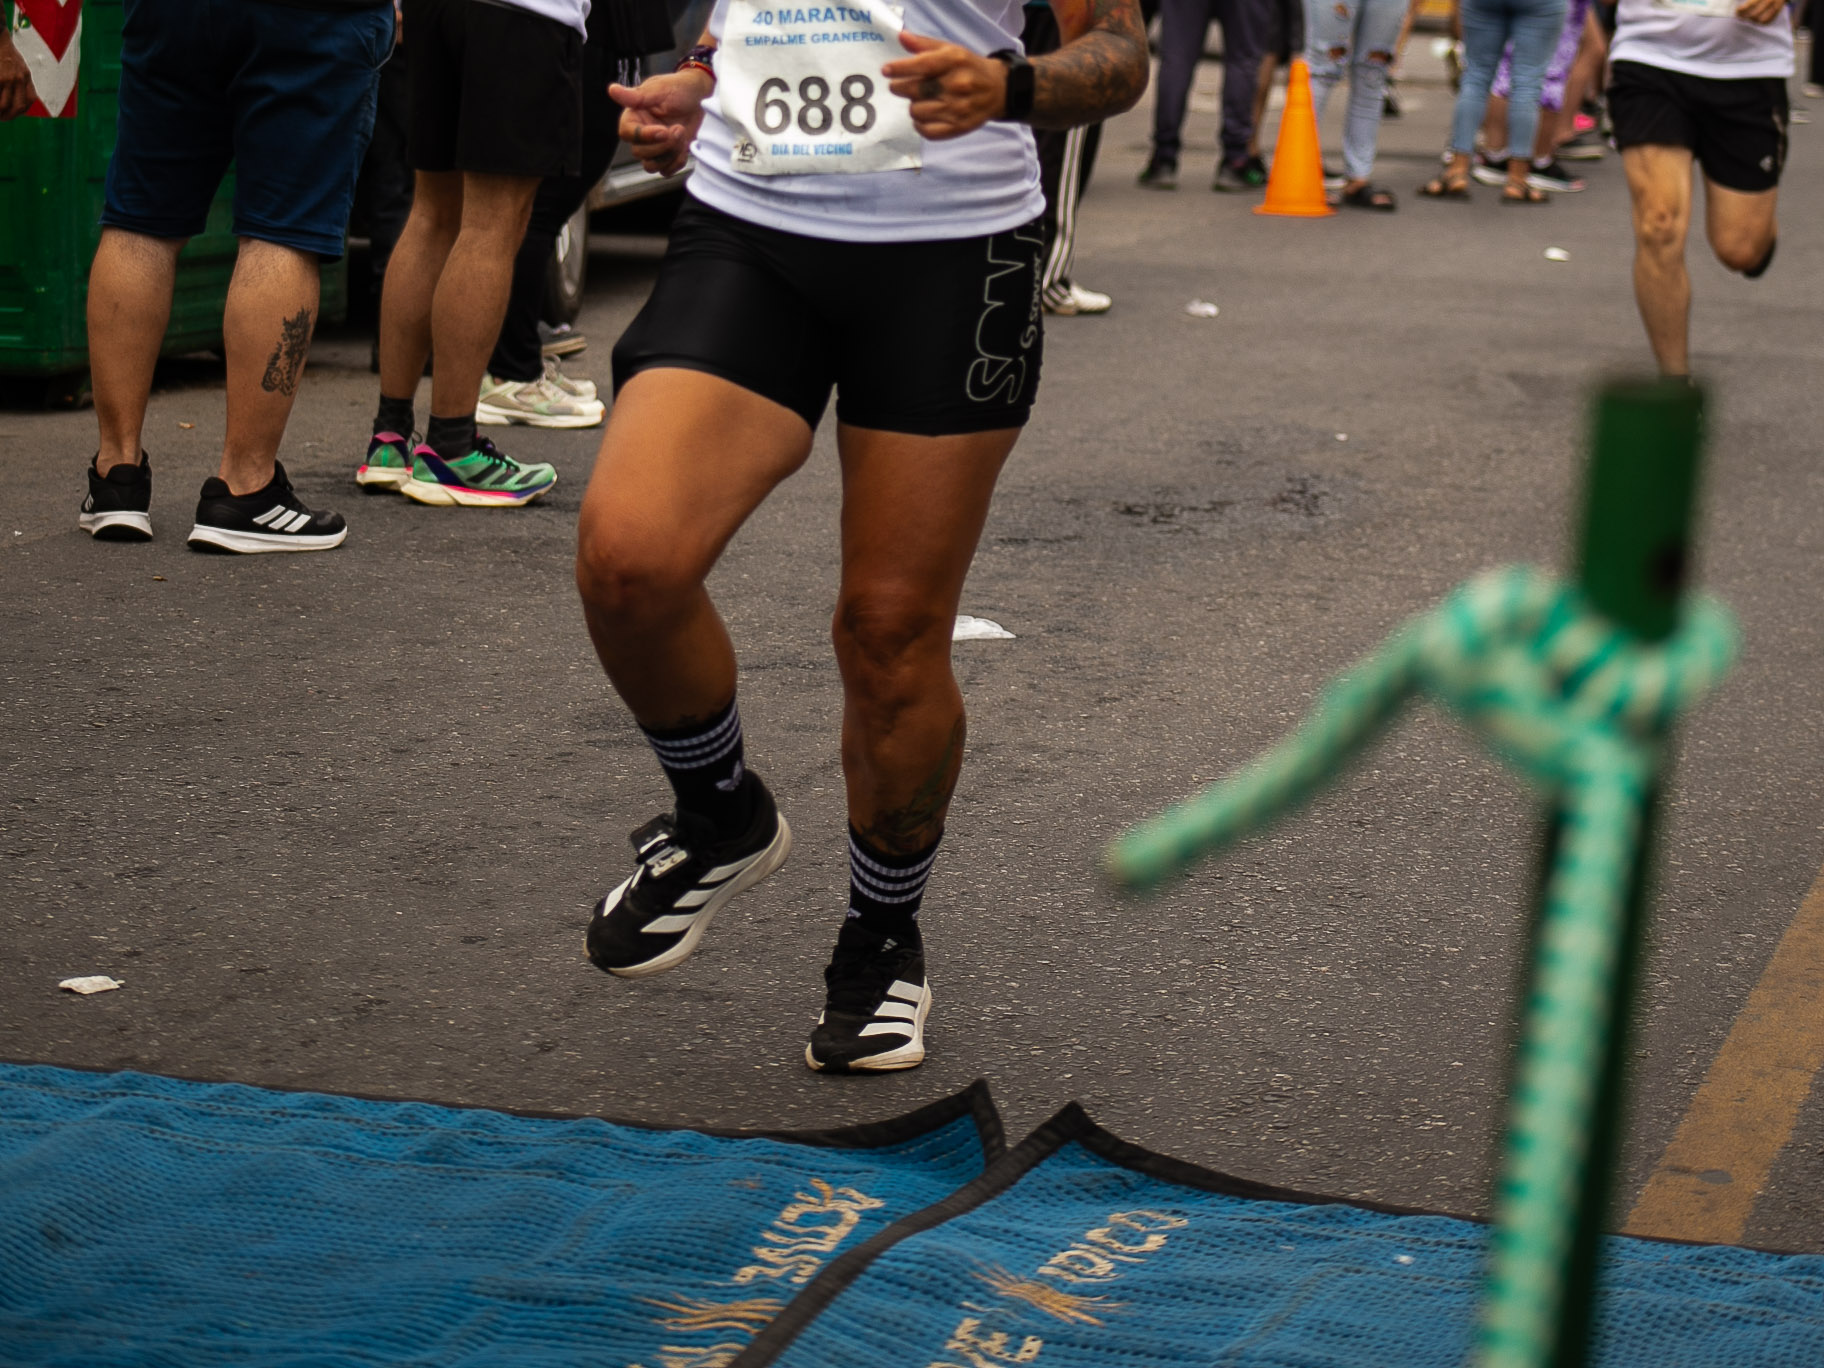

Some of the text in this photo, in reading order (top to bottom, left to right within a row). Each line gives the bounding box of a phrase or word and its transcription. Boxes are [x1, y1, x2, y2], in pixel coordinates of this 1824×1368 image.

[752, 6, 873, 26] 40 MARATON
[745, 33, 807, 47] EMPALME
[753, 73, 877, 136] 688
